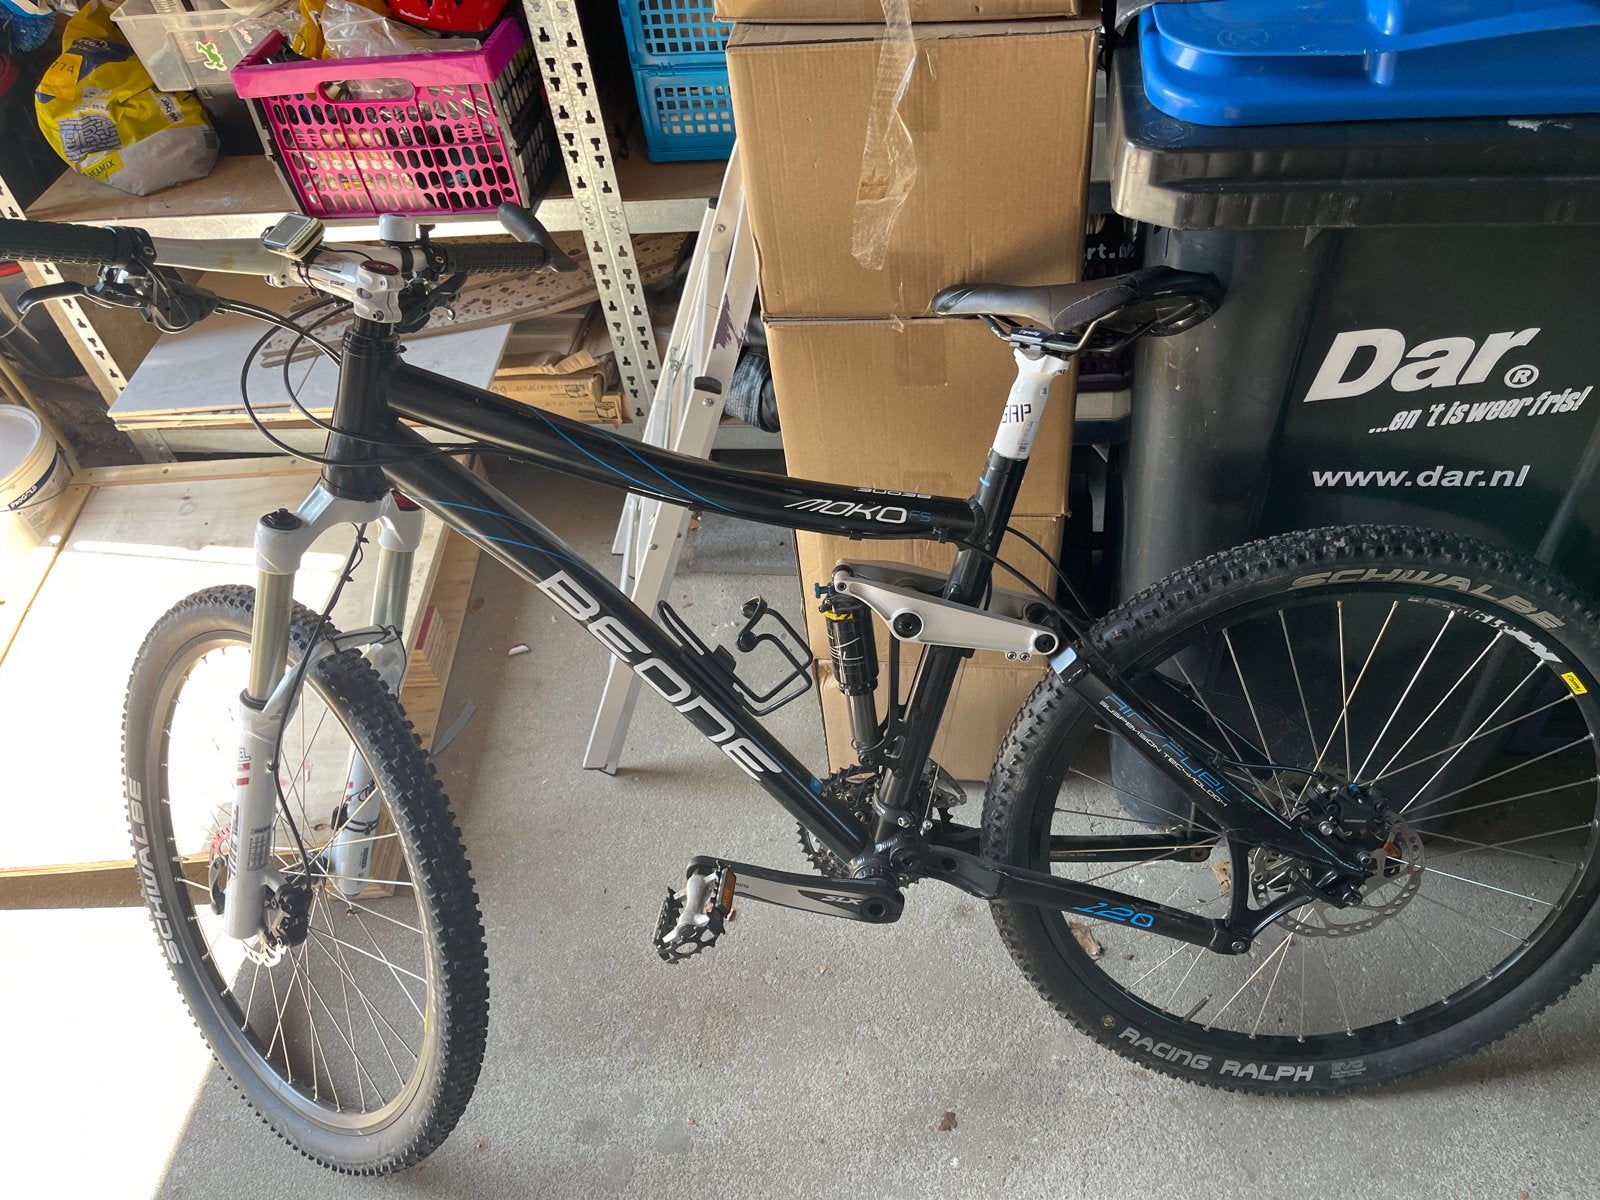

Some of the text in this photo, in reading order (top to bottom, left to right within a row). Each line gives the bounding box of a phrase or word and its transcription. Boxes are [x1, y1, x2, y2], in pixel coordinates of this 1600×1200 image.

[1303, 327, 1541, 403] Dar
[1312, 464, 1531, 488] www.dar.nl
[784, 498, 909, 525] MOKO
[1287, 567, 1567, 630] SCHWALBE
[535, 569, 783, 782] BEONE
[1100, 699, 1162, 754] SUSPENSION
[128, 776, 184, 966] SCHWALBE
[1072, 902, 1155, 929] 120
[1117, 1026, 1314, 1083] RACING RALPH
